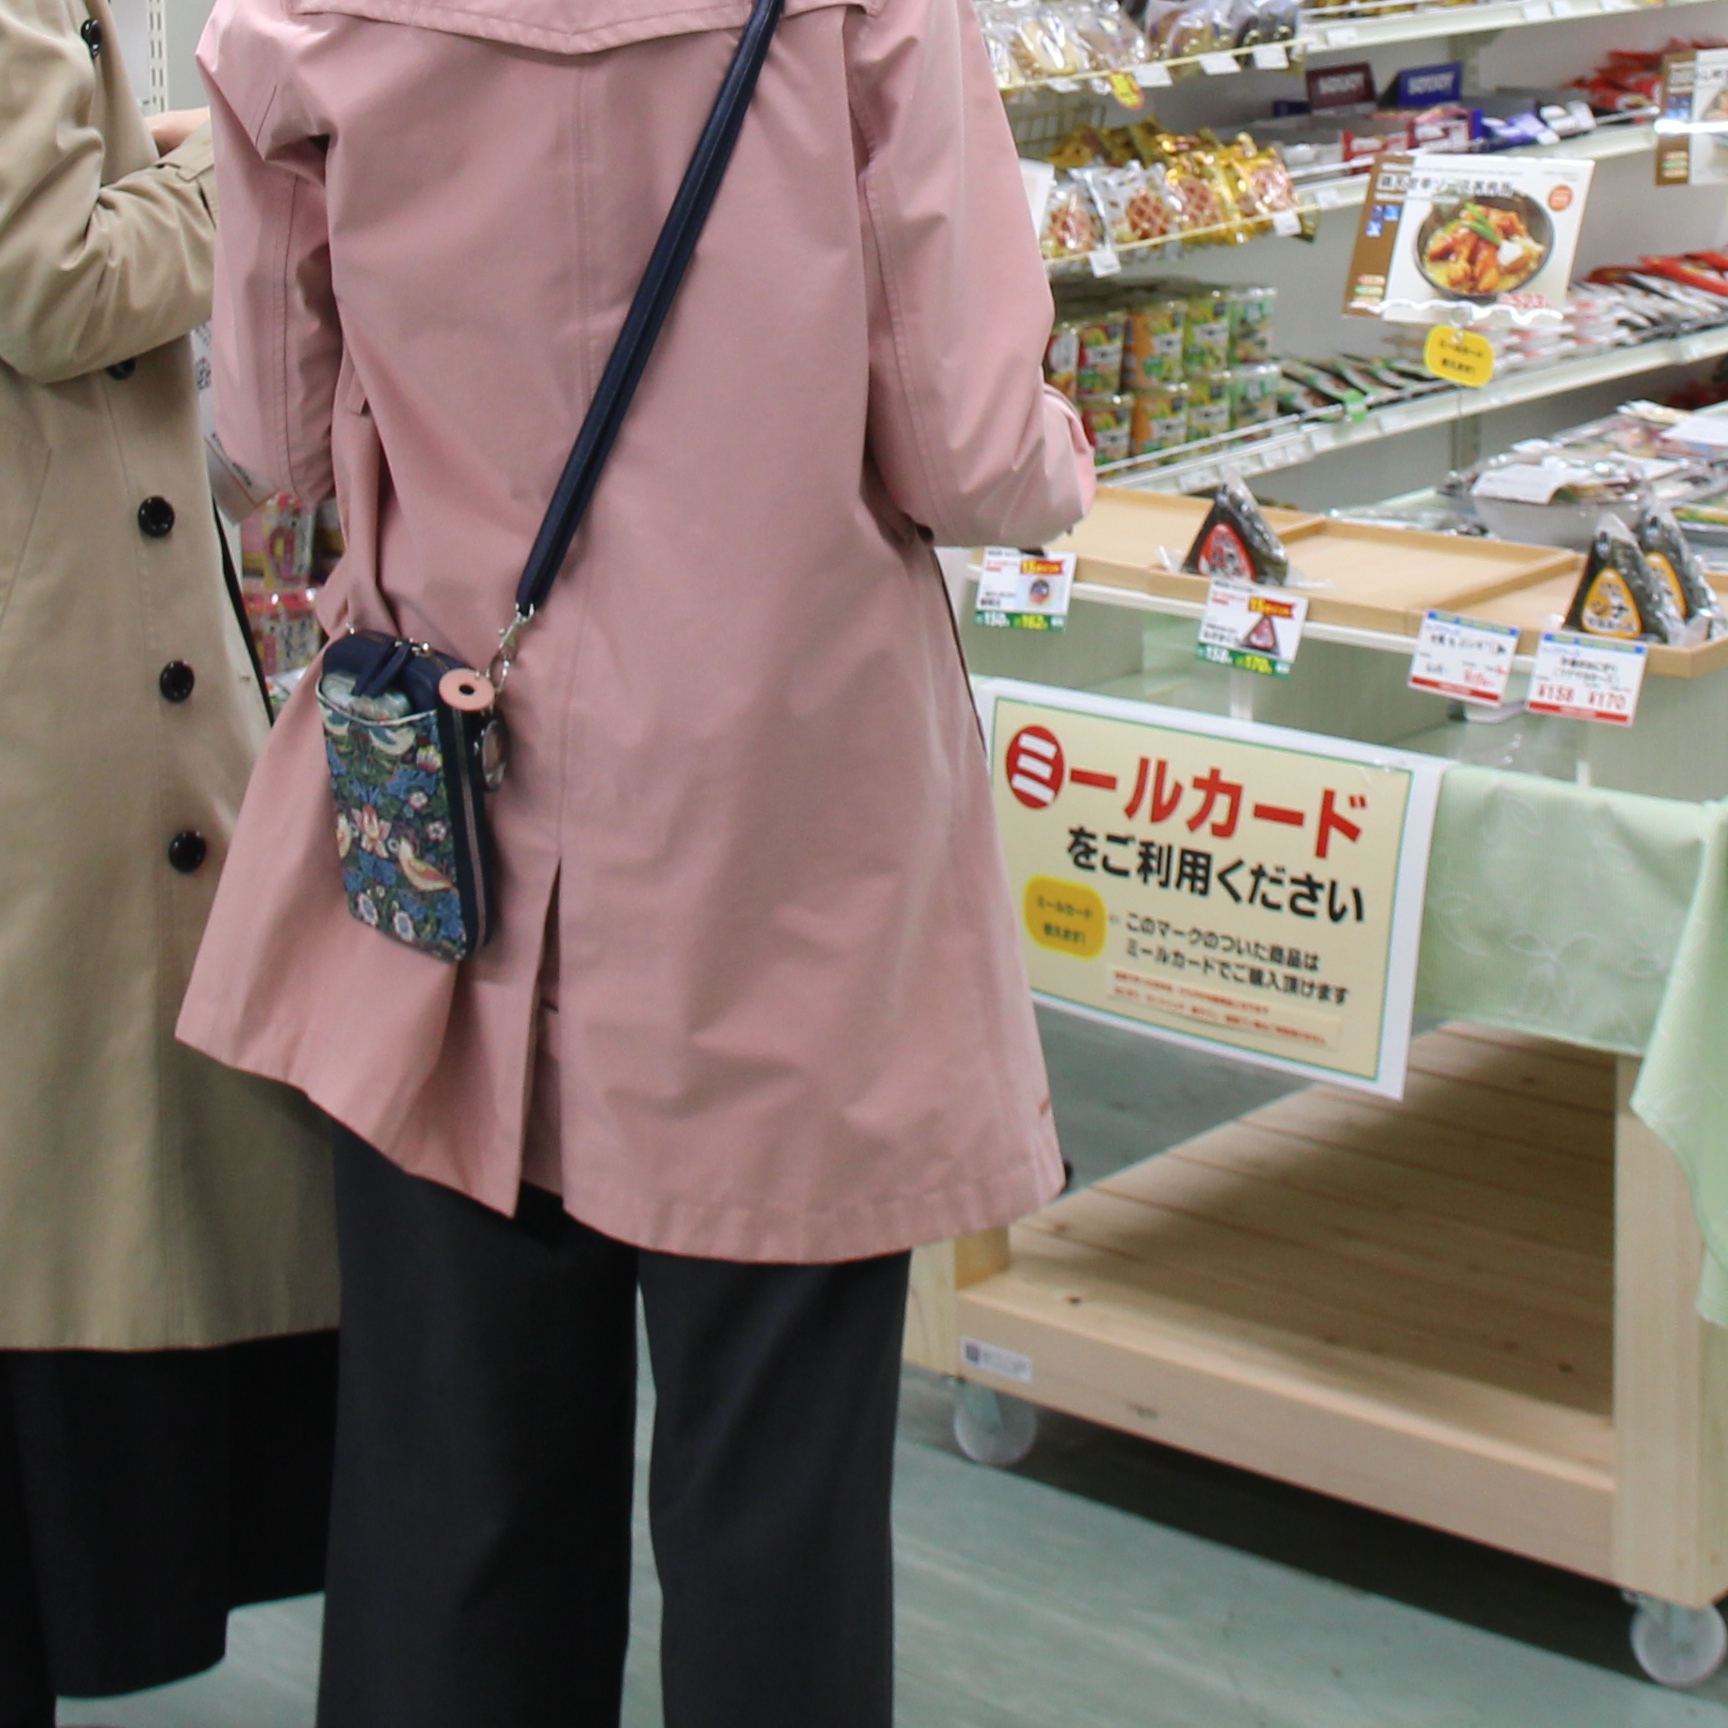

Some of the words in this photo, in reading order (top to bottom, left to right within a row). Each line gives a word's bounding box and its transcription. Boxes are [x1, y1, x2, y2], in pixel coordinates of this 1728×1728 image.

[1006, 725, 1368, 860] ミールカード
[1067, 825, 1365, 925] をご利用ください
[1126, 912, 1321, 972] このマークのついた商品は
[1126, 937, 1350, 1006] ミールカードでご購入頂けます
